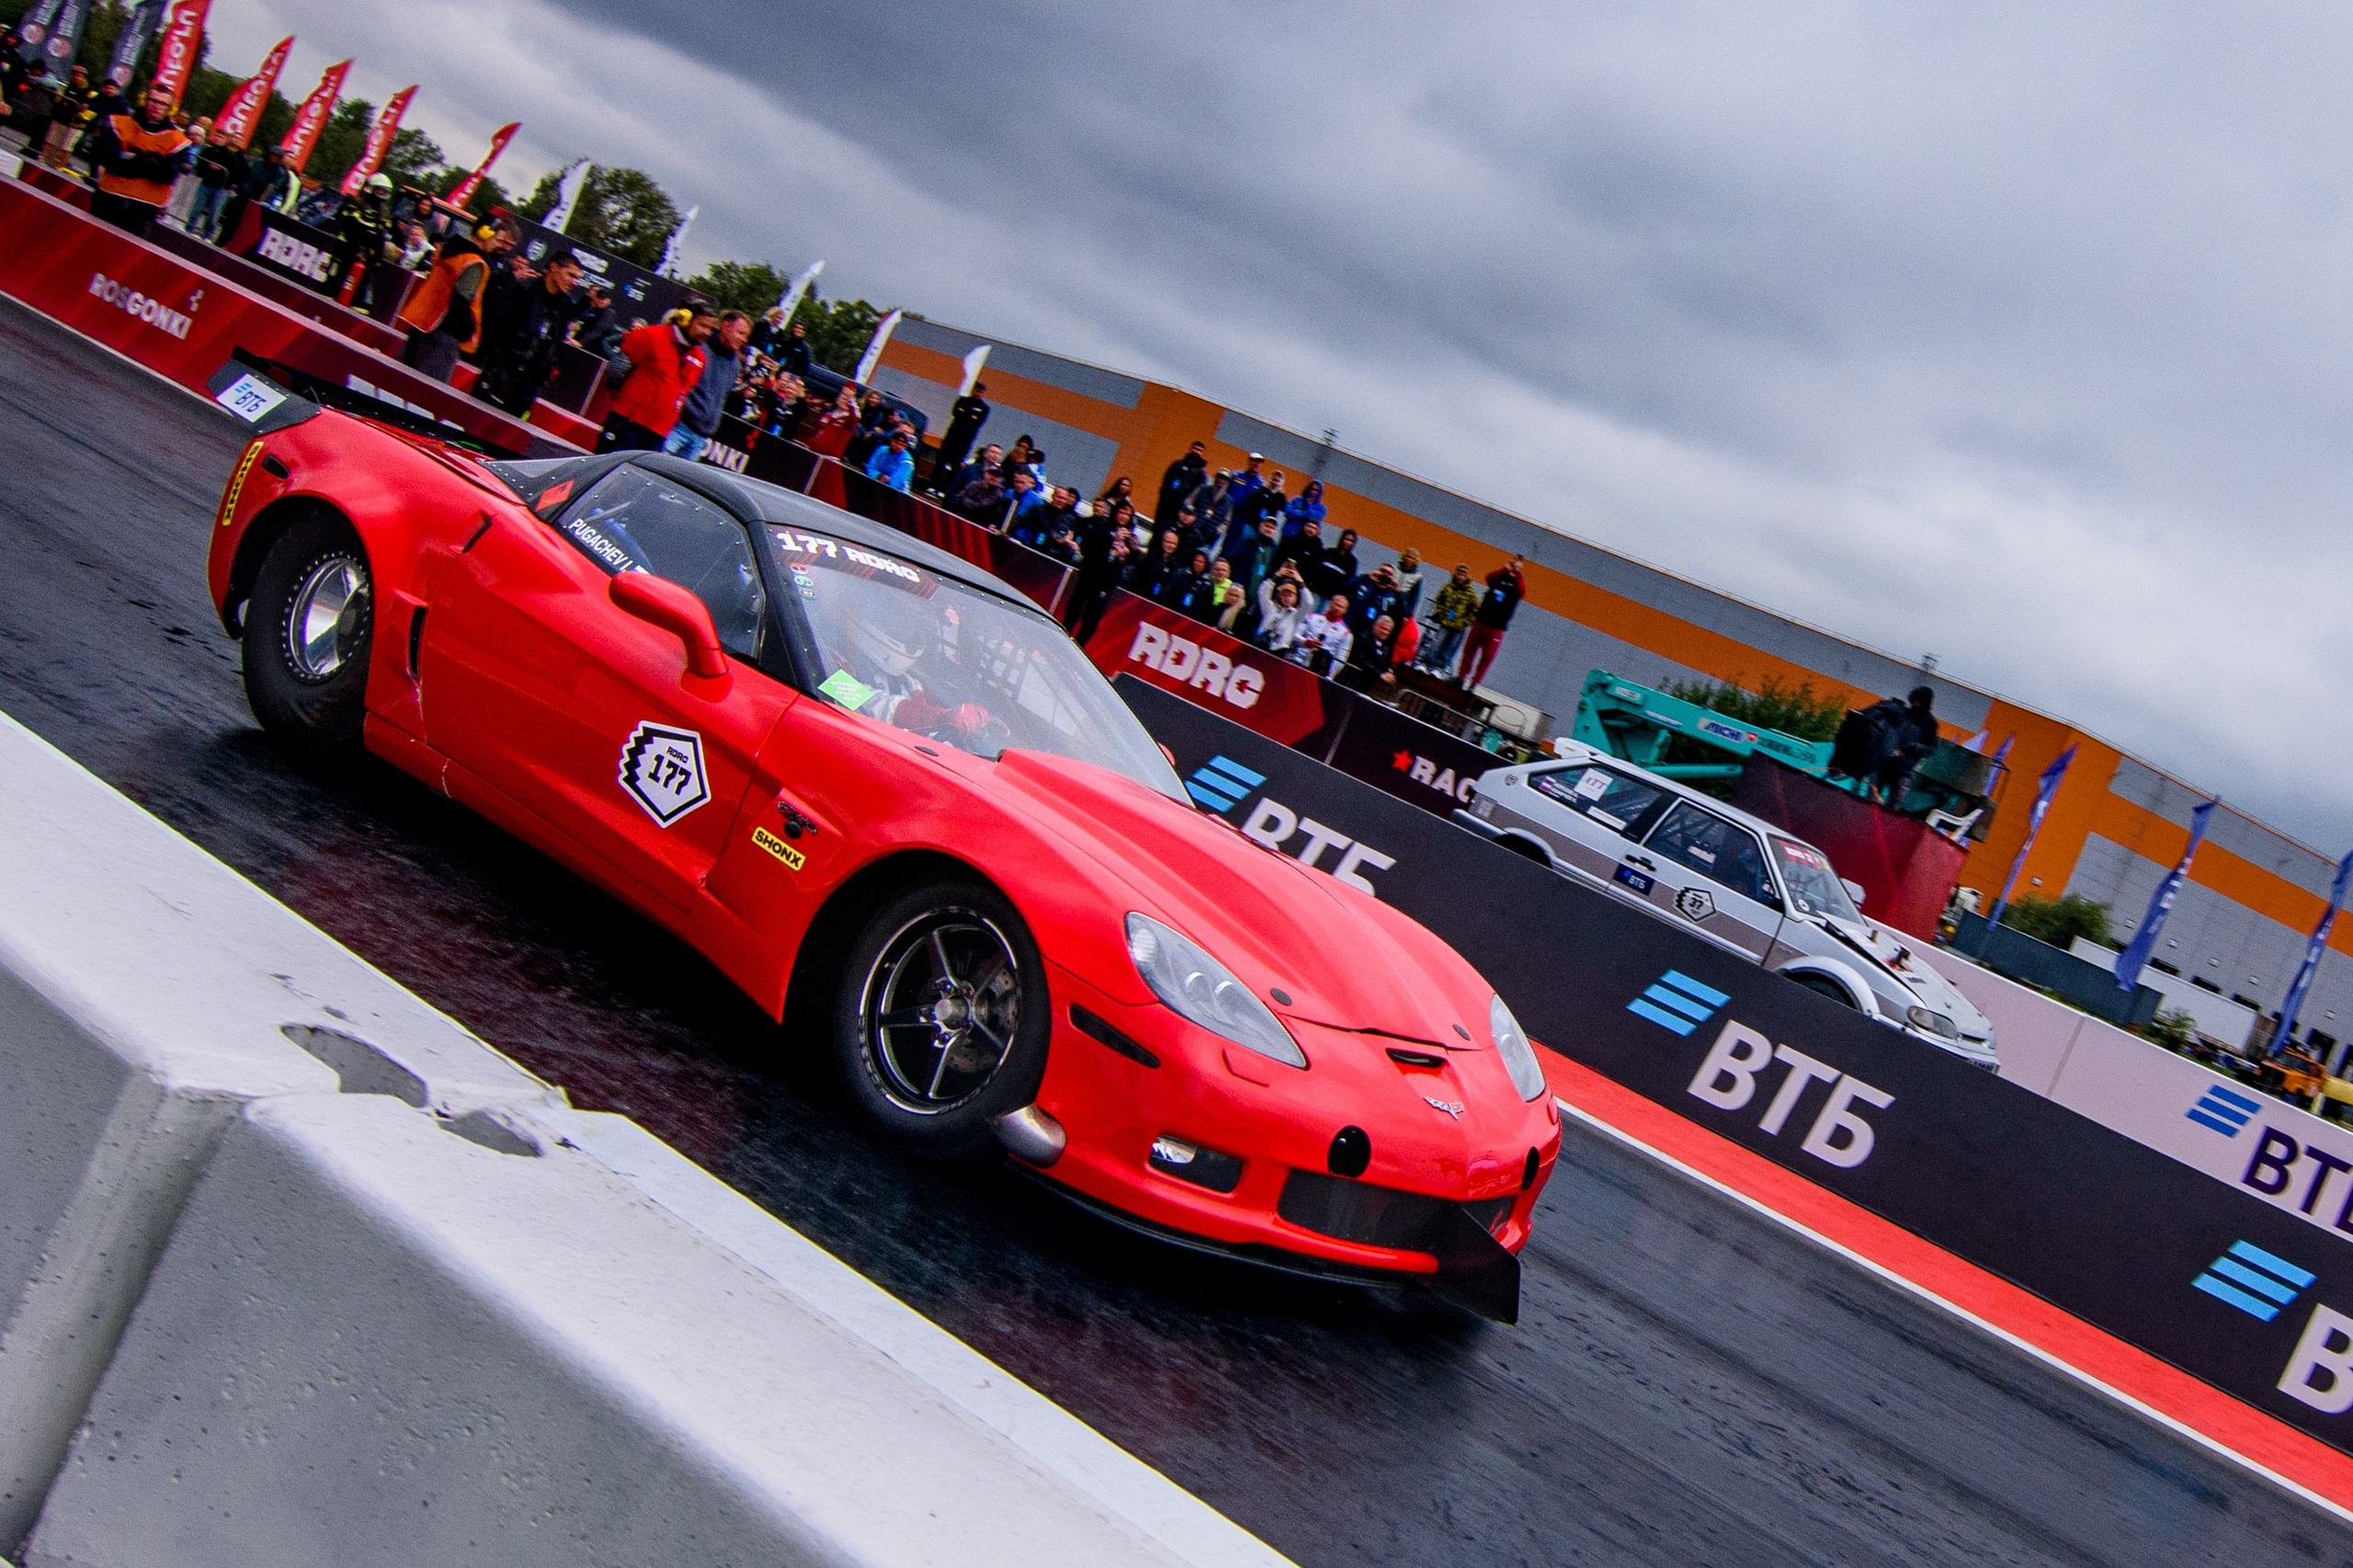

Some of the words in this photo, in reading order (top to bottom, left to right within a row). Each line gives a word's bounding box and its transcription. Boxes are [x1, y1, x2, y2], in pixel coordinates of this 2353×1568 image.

[88, 272, 193, 341] ROSGONKI
[233, 390, 267, 413] ВТБ
[569, 517, 629, 566] PUGACHEV
[775, 530, 839, 560] 177
[1128, 620, 1266, 710] RDRC
[648, 755, 692, 796] 177
[755, 829, 803, 869] SHONX
[1628, 874, 1647, 890] ВТБ
[1688, 896, 1704, 911] 37
[1687, 1018, 1896, 1169] ВТБ
